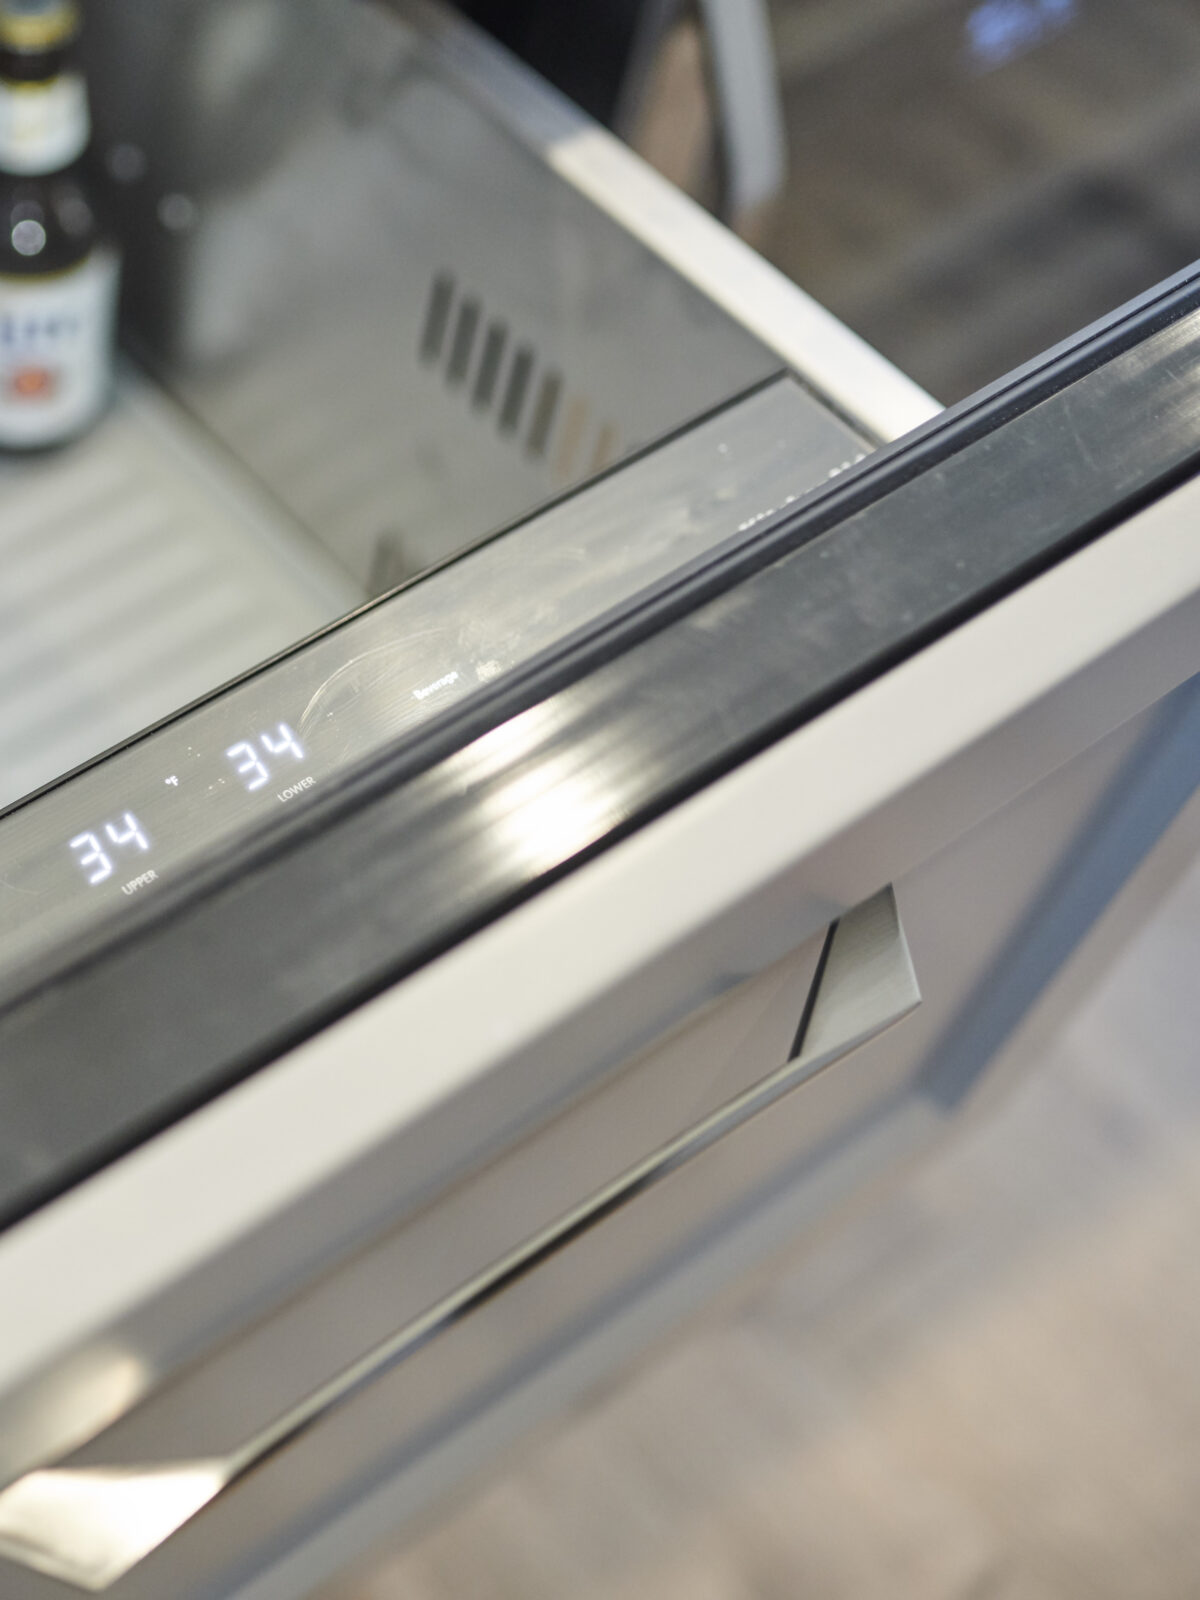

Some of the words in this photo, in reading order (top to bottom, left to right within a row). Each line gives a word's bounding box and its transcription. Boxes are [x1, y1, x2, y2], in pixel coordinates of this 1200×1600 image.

[412, 671, 459, 700] Beverage
[226, 723, 304, 791] 34
[277, 776, 316, 802] LOWER
[68, 811, 149, 884] 34
[121, 869, 159, 895] UPPER
